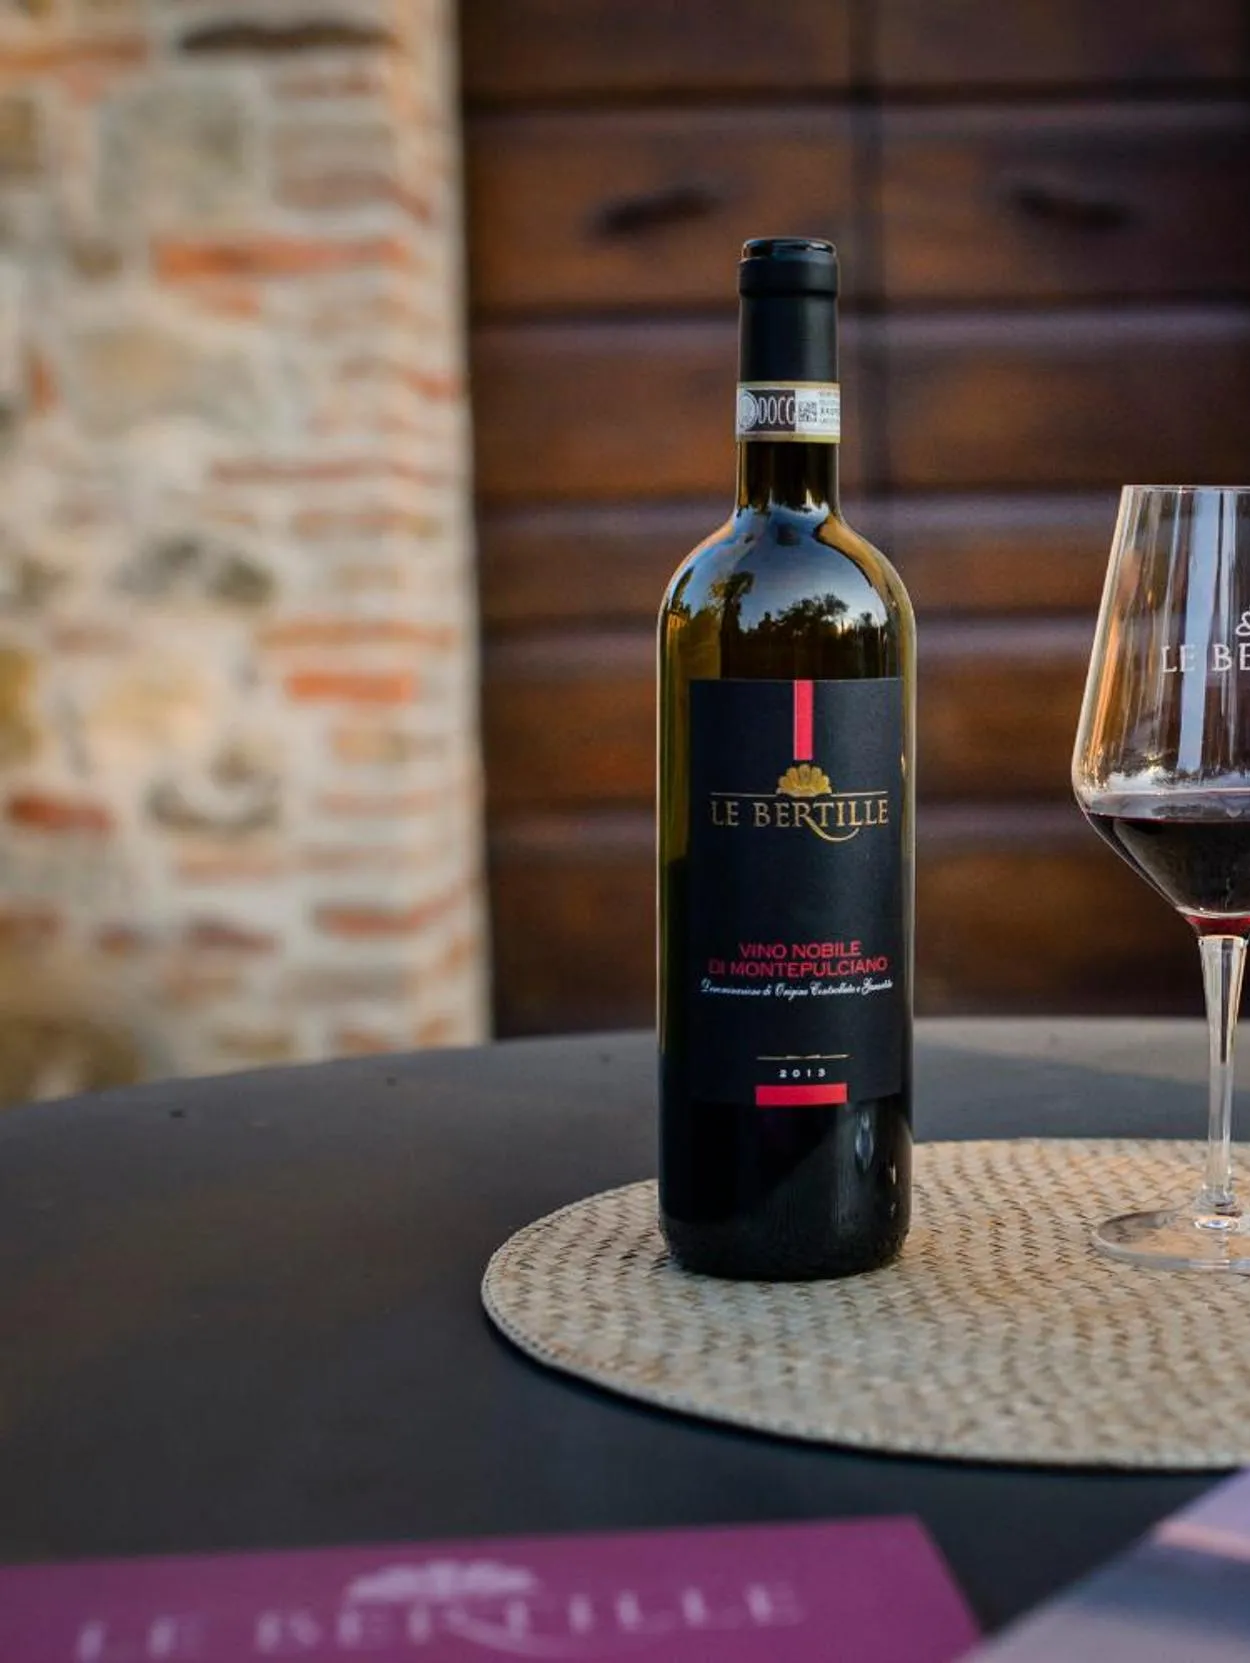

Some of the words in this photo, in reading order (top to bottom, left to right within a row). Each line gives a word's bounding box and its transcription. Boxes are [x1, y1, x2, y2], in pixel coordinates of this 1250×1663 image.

[1161, 644, 1197, 673] LE
[710, 799, 740, 827] LE
[753, 798, 890, 842] BERTILLE
[739, 942, 787, 960] VINO
[792, 939, 863, 959] NOBILE
[708, 959, 726, 975] DI
[730, 956, 888, 978] MONTEPULCIANO
[778, 1067, 827, 1079] 2013
